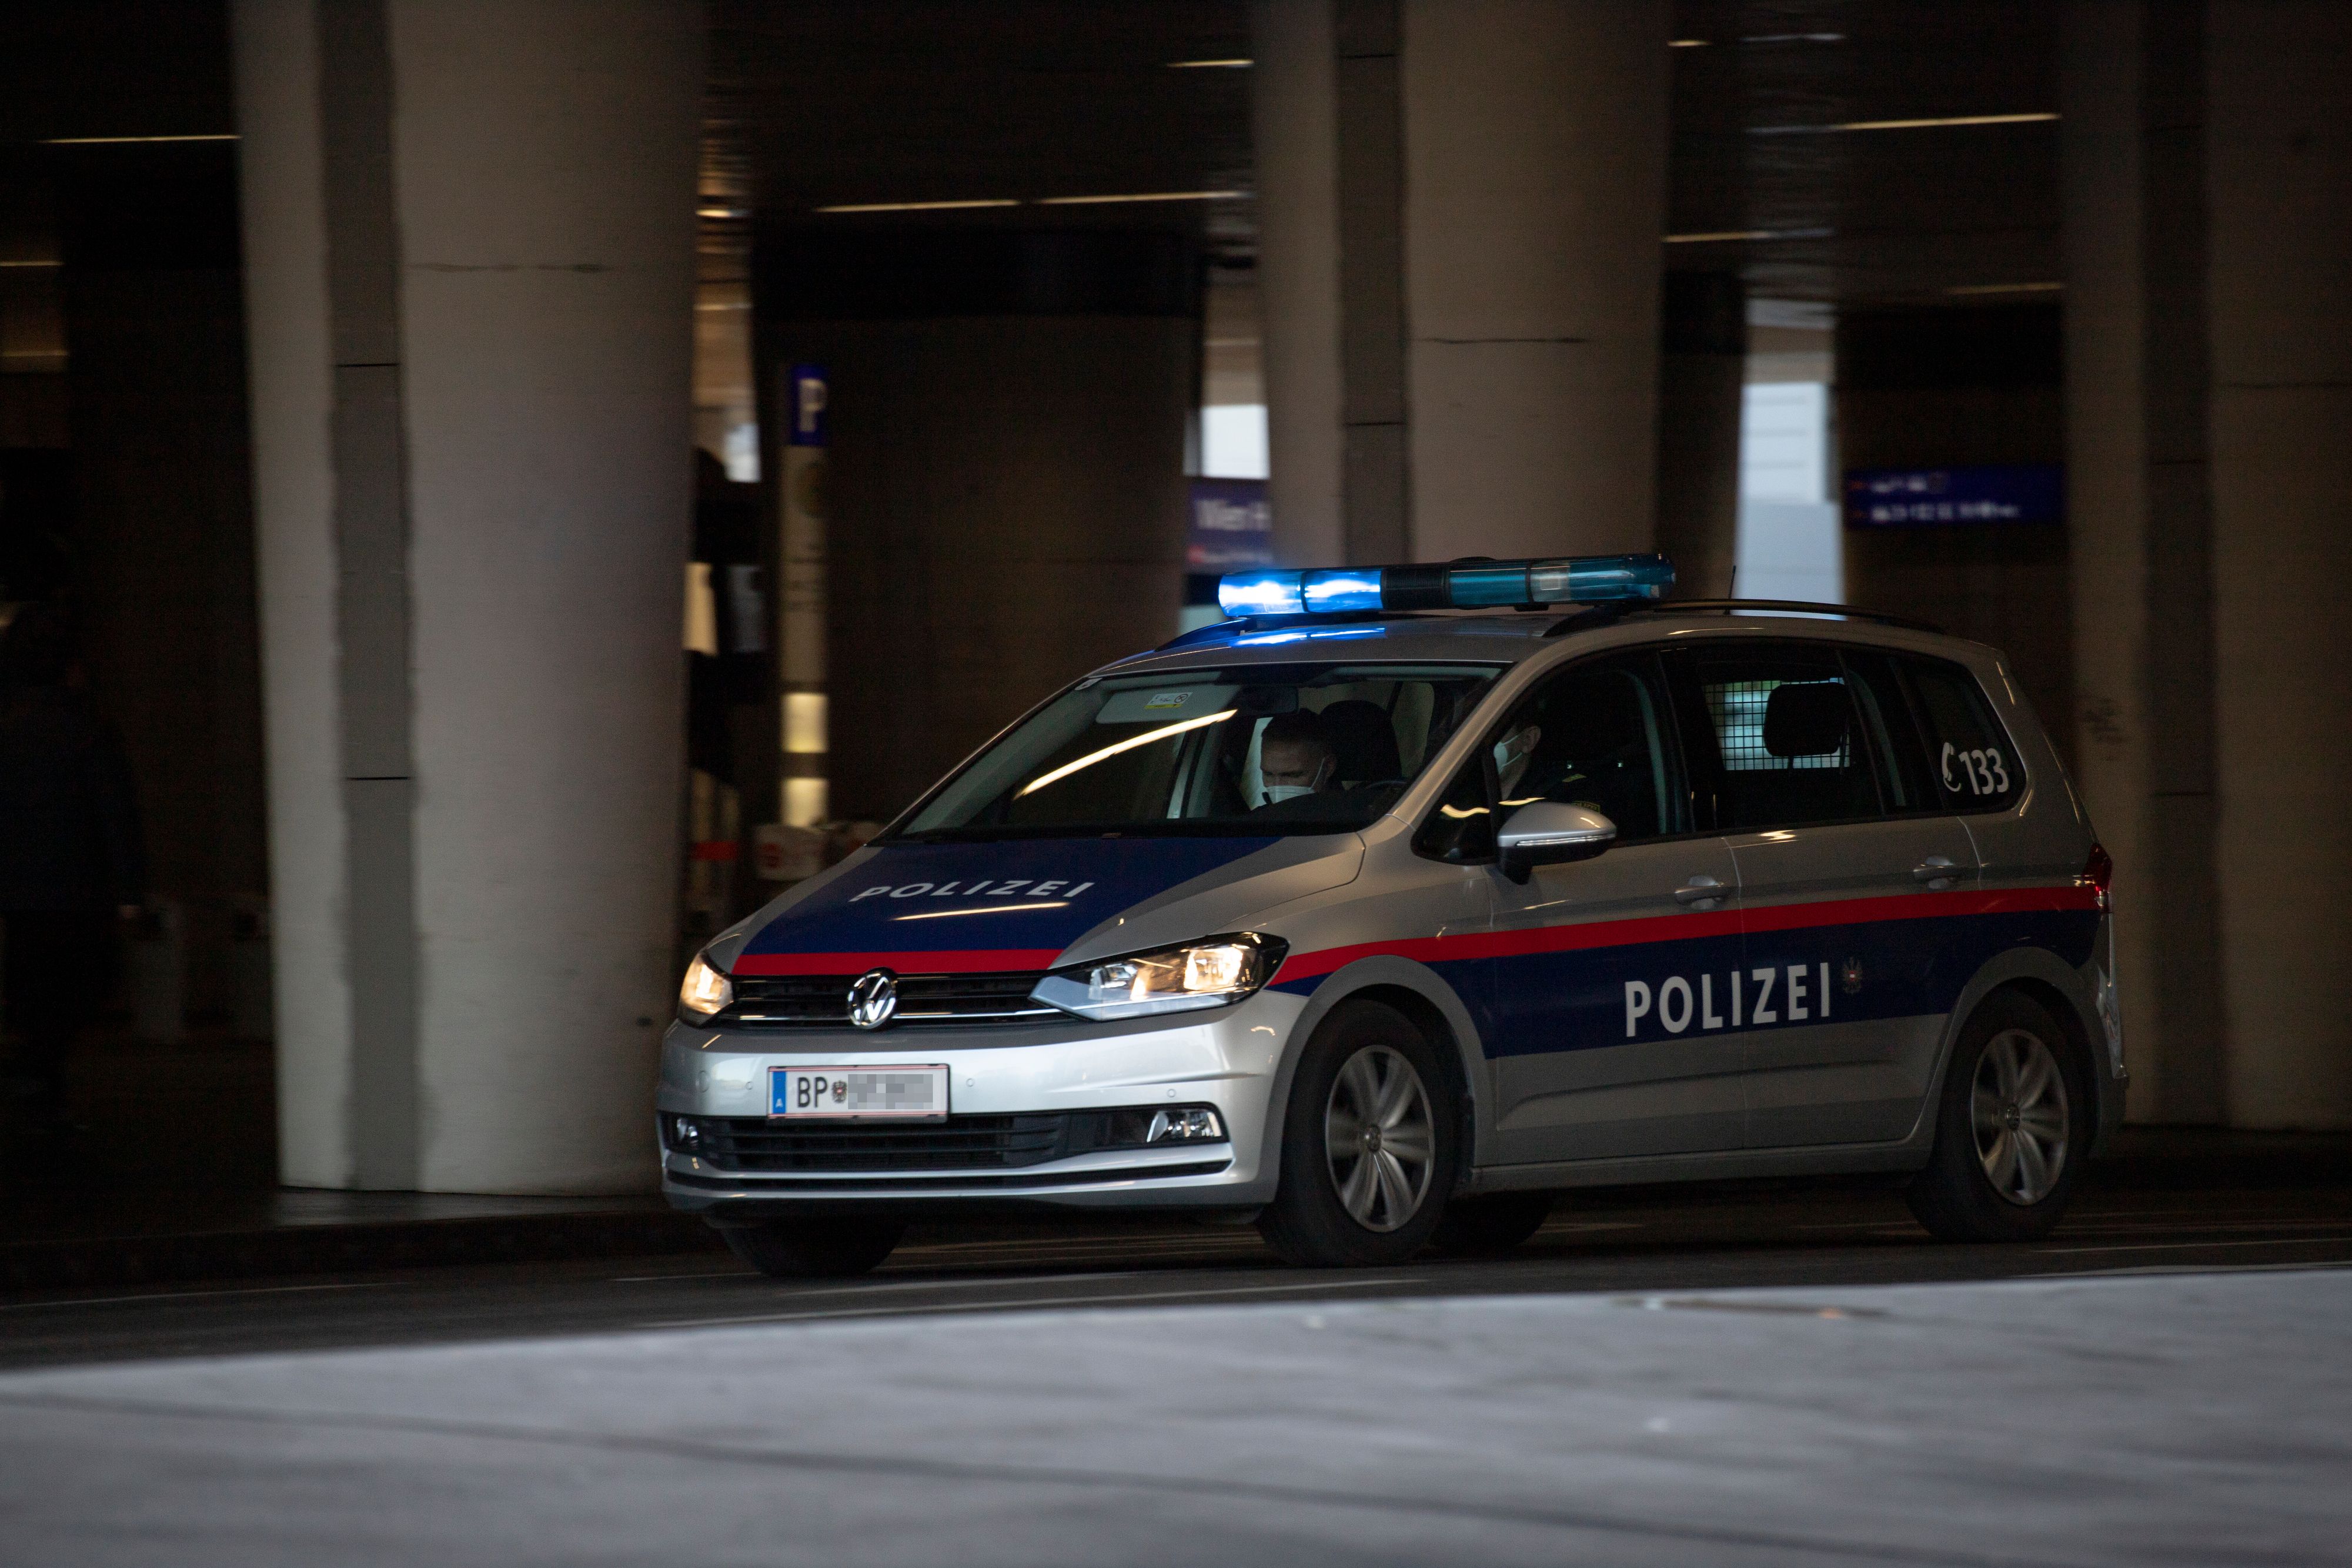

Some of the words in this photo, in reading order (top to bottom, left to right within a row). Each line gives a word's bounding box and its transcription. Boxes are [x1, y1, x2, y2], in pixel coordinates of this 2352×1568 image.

[1958, 748, 2009, 794] 133
[847, 880, 1095, 902] POLIZEI
[1625, 962, 1830, 1037] POLIZEI
[797, 1076, 828, 1107] BP
